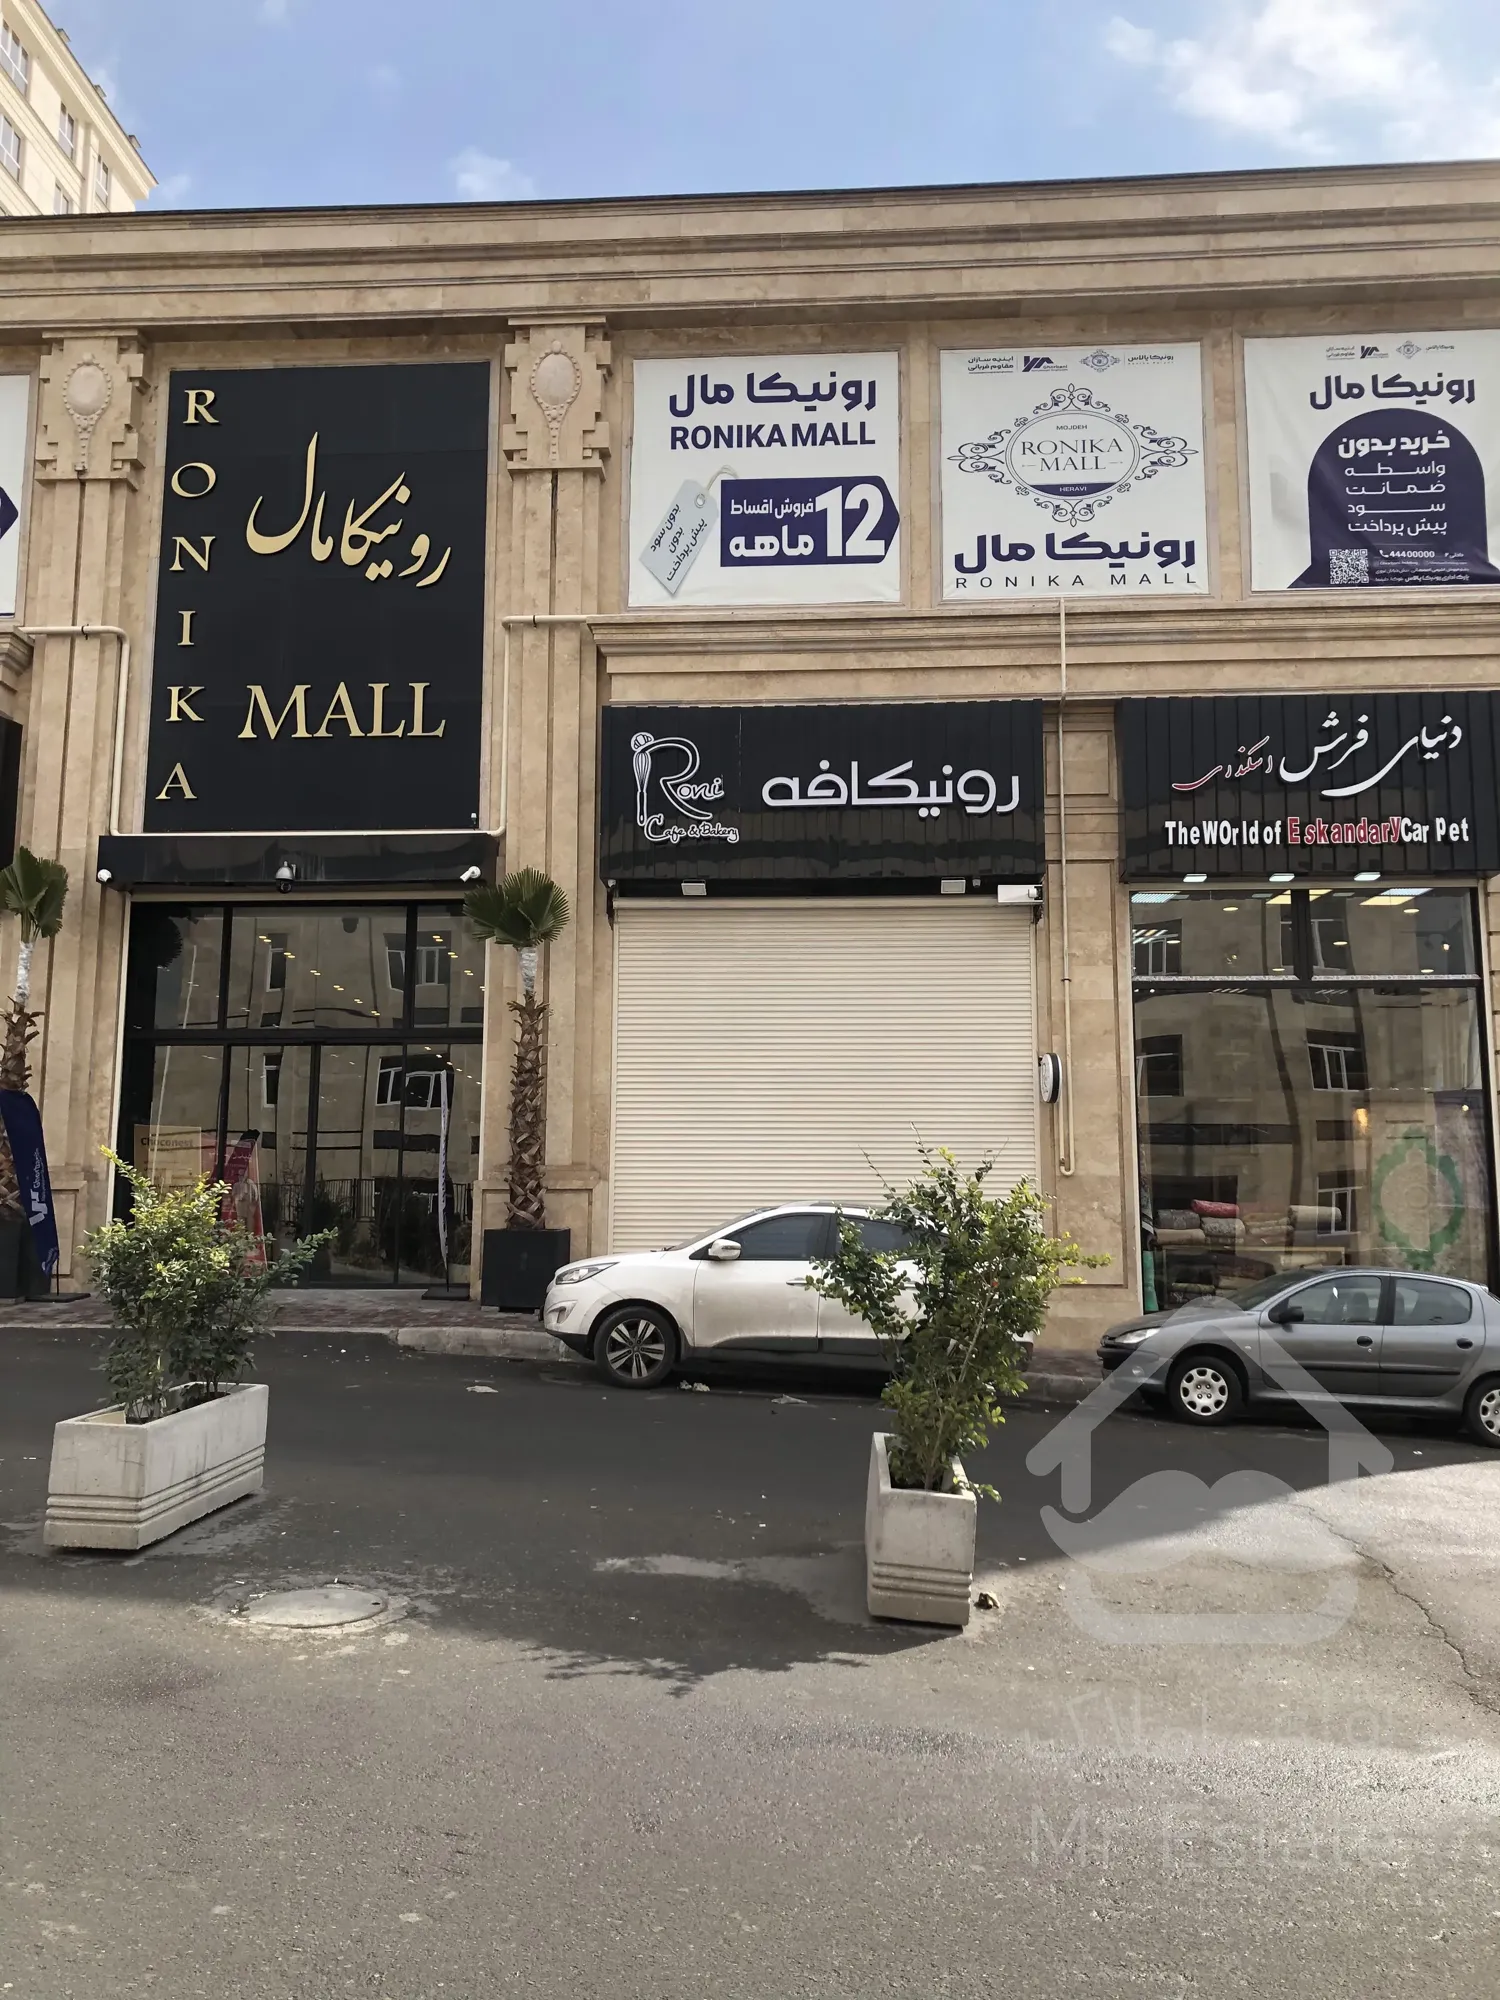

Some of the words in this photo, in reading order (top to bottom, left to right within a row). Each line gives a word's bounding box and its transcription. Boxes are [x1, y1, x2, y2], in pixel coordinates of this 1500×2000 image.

[669, 374, 735, 418] مال
[746, 371, 877, 413] رونیکا
[1309, 374, 1365, 410] مال
[1371, 372, 1475, 405] رونیکا
[670, 424, 788, 450] RONIKA
[791, 421, 876, 447] MALL
[1021, 438, 1123, 456] RONIKA
[1338, 436, 1396, 459] بدون
[1400, 430, 1450, 456] خرید
[1040, 456, 1106, 472] MALL
[1344, 461, 1446, 478] واسطه
[1059, 485, 1087, 493] HERAVI
[1345, 480, 1446, 495] ضمانت
[666, 503, 681, 531] بدون
[730, 498, 773, 515] اقساط
[775, 497, 814, 519] فروش
[815, 483, 886, 557] 12
[1347, 500, 1446, 516] سود
[650, 528, 666, 552] سود
[668, 527, 684, 554] بدون
[690, 518, 708, 547] پیش
[1347, 518, 1405, 537] پرداخت
[1407, 517, 1448, 536] پیش
[729, 524, 815, 558] ماهه
[954, 534, 1036, 574] مال
[1045, 531, 1196, 569] رونیکا
[1389, 550, 1435, 558] 44400000
[667, 544, 693, 581] پرداخت
[154, 388, 219, 800] RONIKA
[955, 575, 1085, 589] RONIKA
[1110, 572, 1197, 586] MALL
[237, 681, 446, 740] MALL
[1279, 711, 1370, 783] فرش
[1321, 716, 1464, 797] دنیای
[632, 735, 725, 822] Roni
[761, 759, 1020, 818] رونیکافه
[644, 813, 686, 844] Cafe
[687, 823, 700, 838] &
[699, 821, 740, 843] Bakery
[1164, 820, 1200, 845] The
[1263, 820, 1282, 845] of
